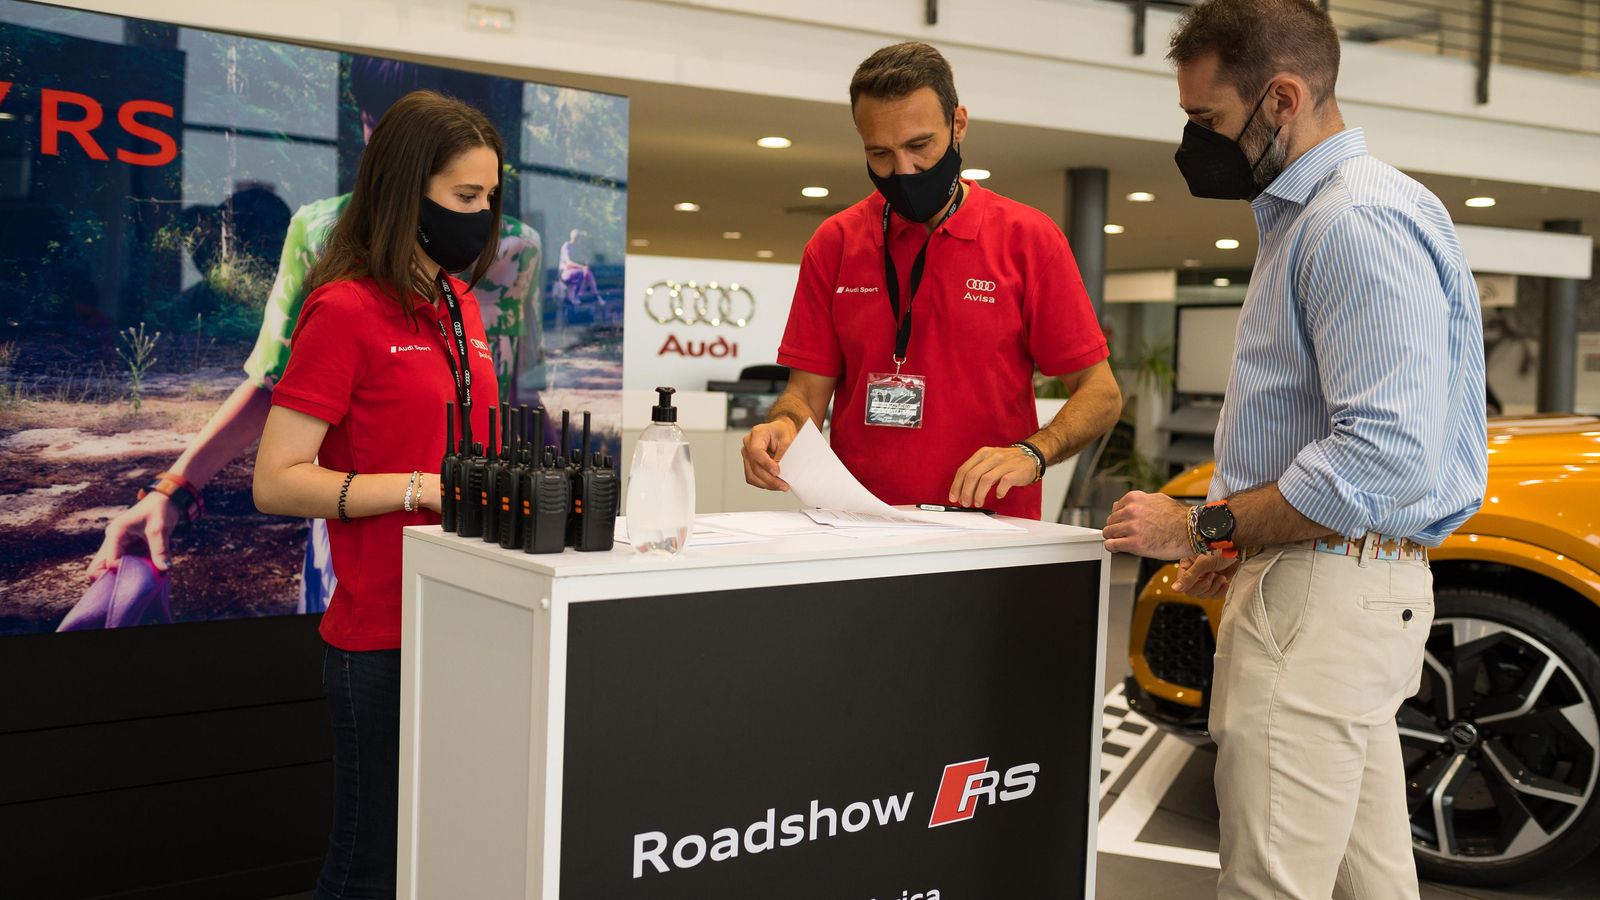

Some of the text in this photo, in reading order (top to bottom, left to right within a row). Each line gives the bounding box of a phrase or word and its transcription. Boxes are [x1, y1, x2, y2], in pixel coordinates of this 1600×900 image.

[40, 88, 178, 167] RS
[963, 292, 995, 303] Avisa
[658, 335, 737, 358] Audi
[633, 762, 1040, 879] Roadshow RS
